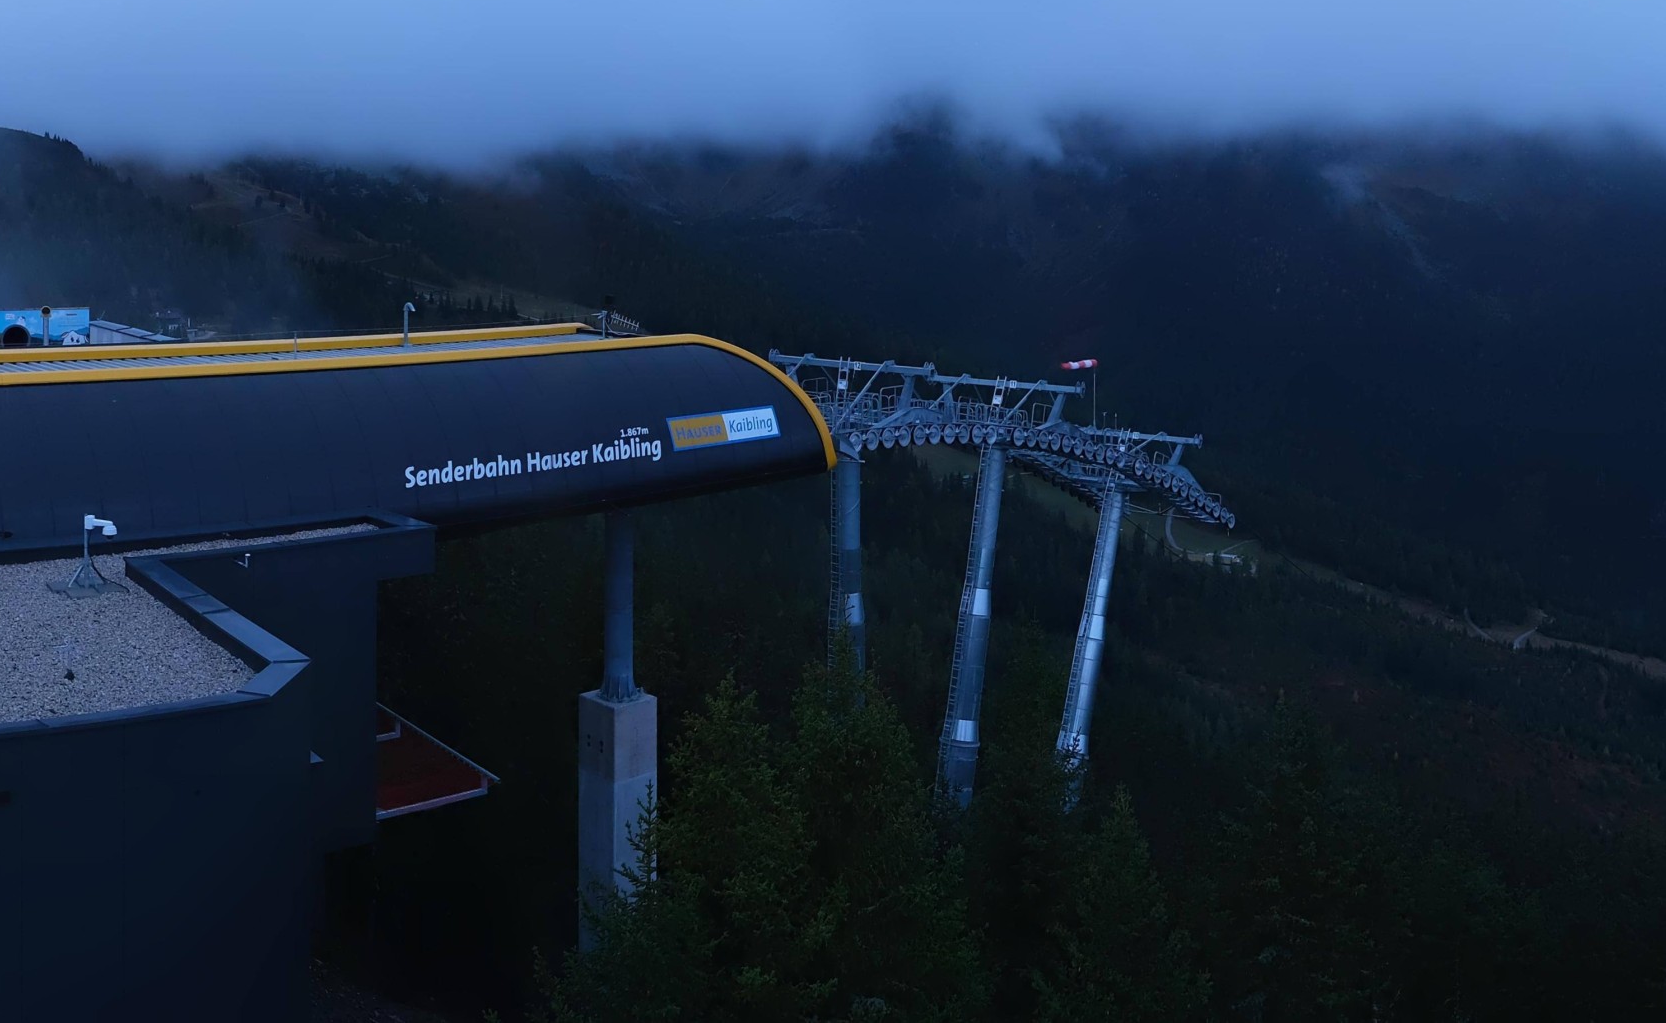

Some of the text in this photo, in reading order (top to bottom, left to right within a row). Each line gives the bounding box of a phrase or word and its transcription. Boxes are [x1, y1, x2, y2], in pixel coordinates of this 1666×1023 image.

[620, 427, 649, 438] 1.867m
[676, 417, 773, 440] HAUSER Kaibling
[405, 438, 662, 488] Senderbahn Hauser Kaibling
